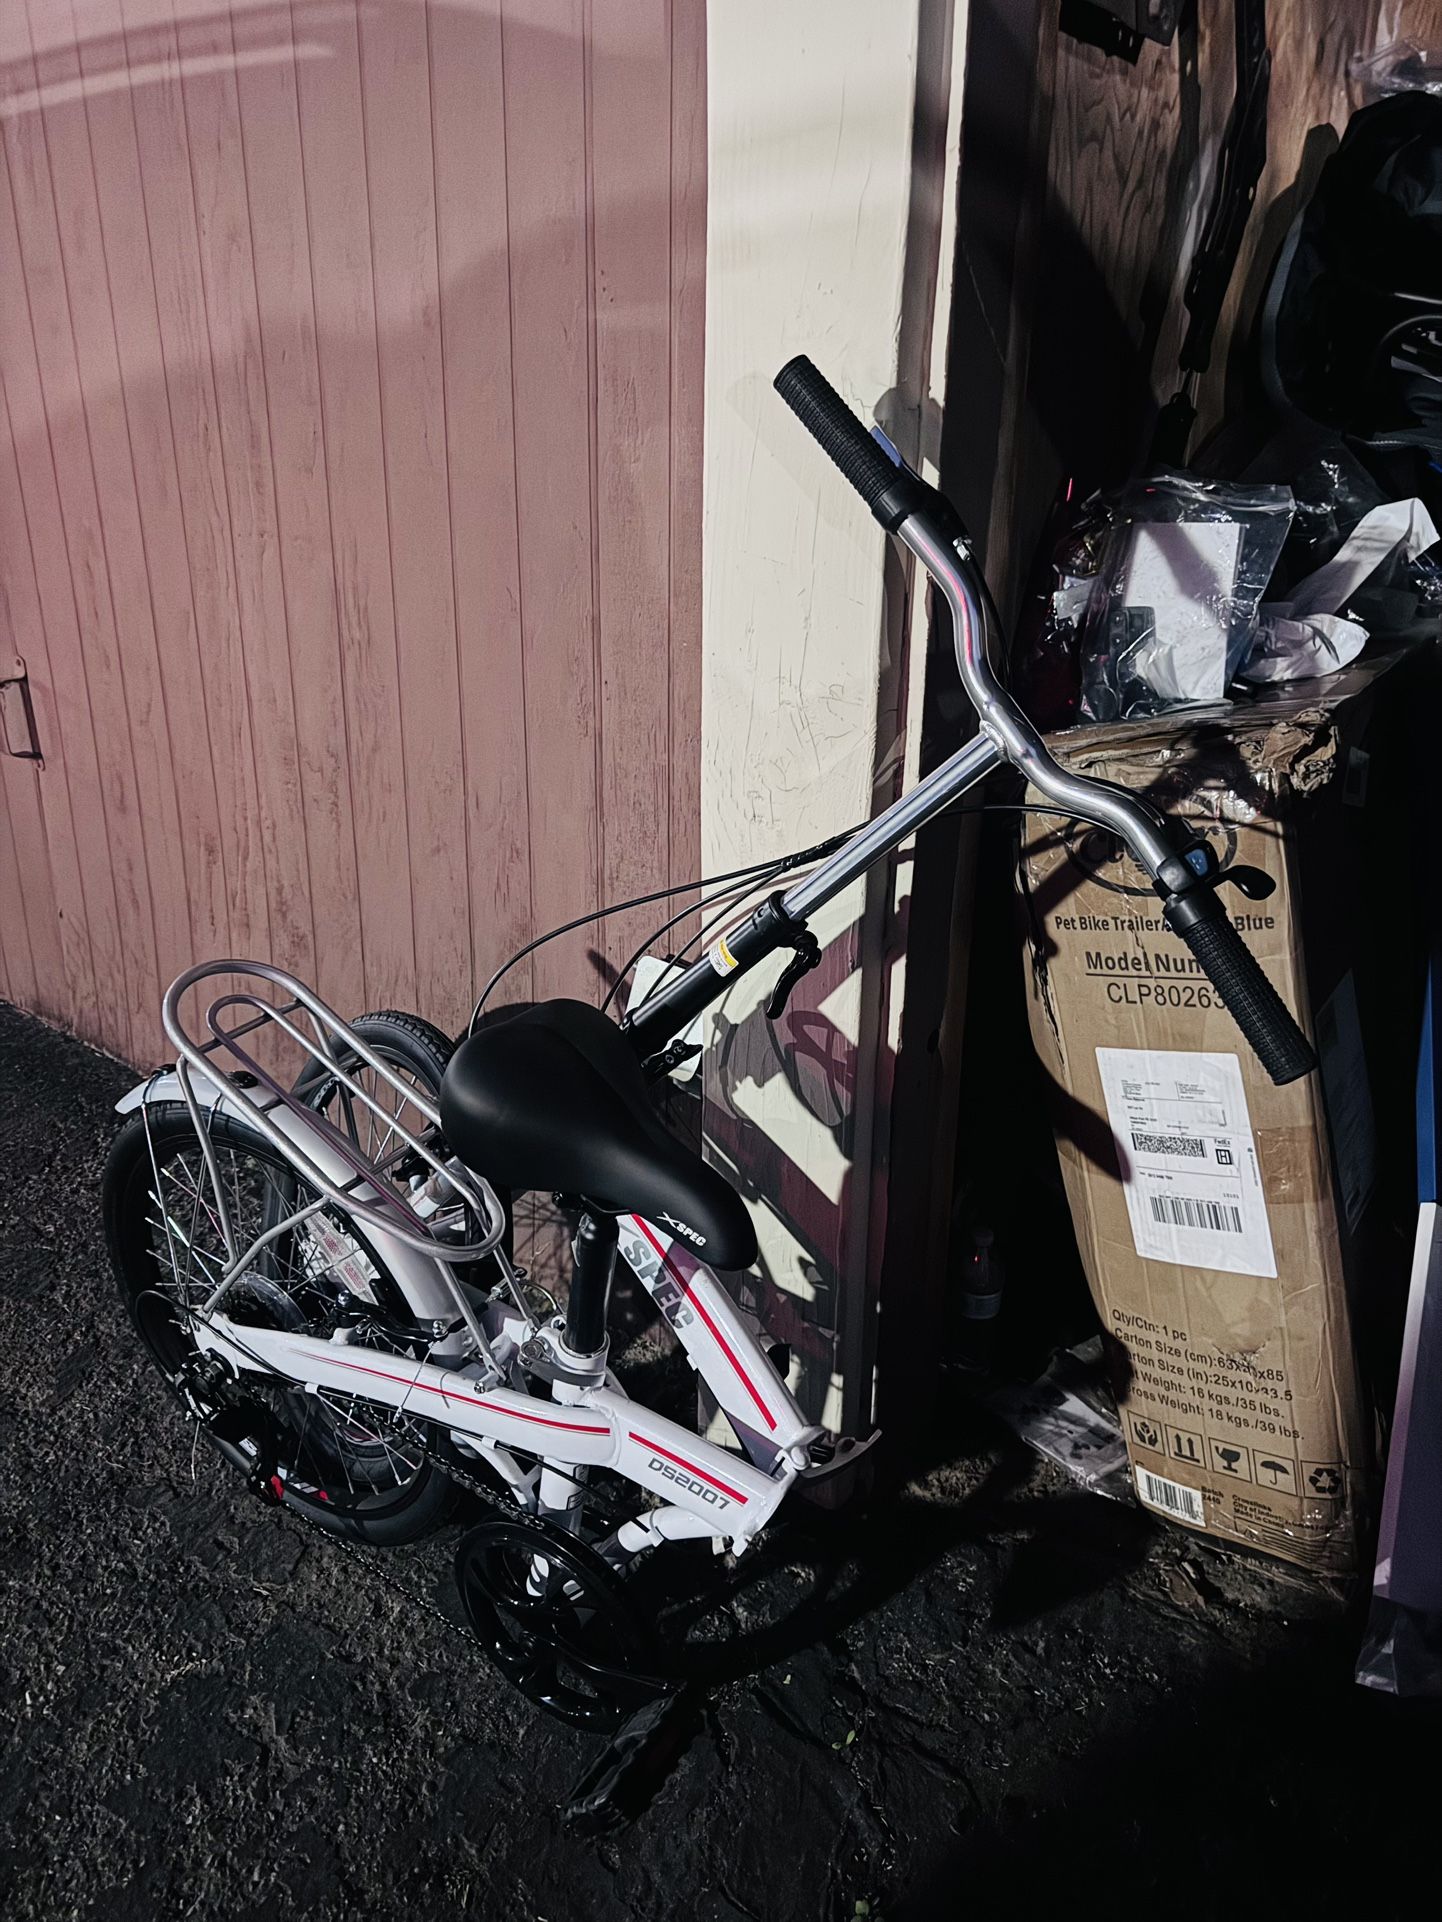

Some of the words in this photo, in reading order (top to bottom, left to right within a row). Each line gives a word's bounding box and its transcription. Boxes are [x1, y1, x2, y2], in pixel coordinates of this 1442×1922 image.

[1055, 916, 1076, 931] Pet
[1079, 915, 1110, 932] Bike
[1234, 914, 1275, 931] Blue
[1085, 951, 1150, 972] Model
[1154, 953, 1201, 974] Num
[656, 1211, 707, 1248] XSPEC
[623, 1239, 695, 1329] SPEC
[1112, 1308, 1161, 1335] Qty/Ctn:
[1162, 1325, 1169, 1337] 1
[1172, 1329, 1188, 1342] pc
[1114, 1327, 1153, 1350] Carton
[1154, 1340, 1182, 1358] Size
[1122, 1350, 1156, 1369] arton
[1157, 1359, 1185, 1376] Size
[1140, 1370, 1187, 1395] Weight:
[1189, 1385, 1206, 1400] 16
[1207, 1389, 1258, 1412] kgs./35
[1259, 1401, 1285, 1419] lbs.
[1157, 1392, 1205, 1418] Weight:
[1207, 1407, 1225, 1421] 18
[1226, 1411, 1276, 1434] kgs./39
[1279, 1424, 1305, 1441] lbs.
[647, 1457, 731, 1510] DS2007
